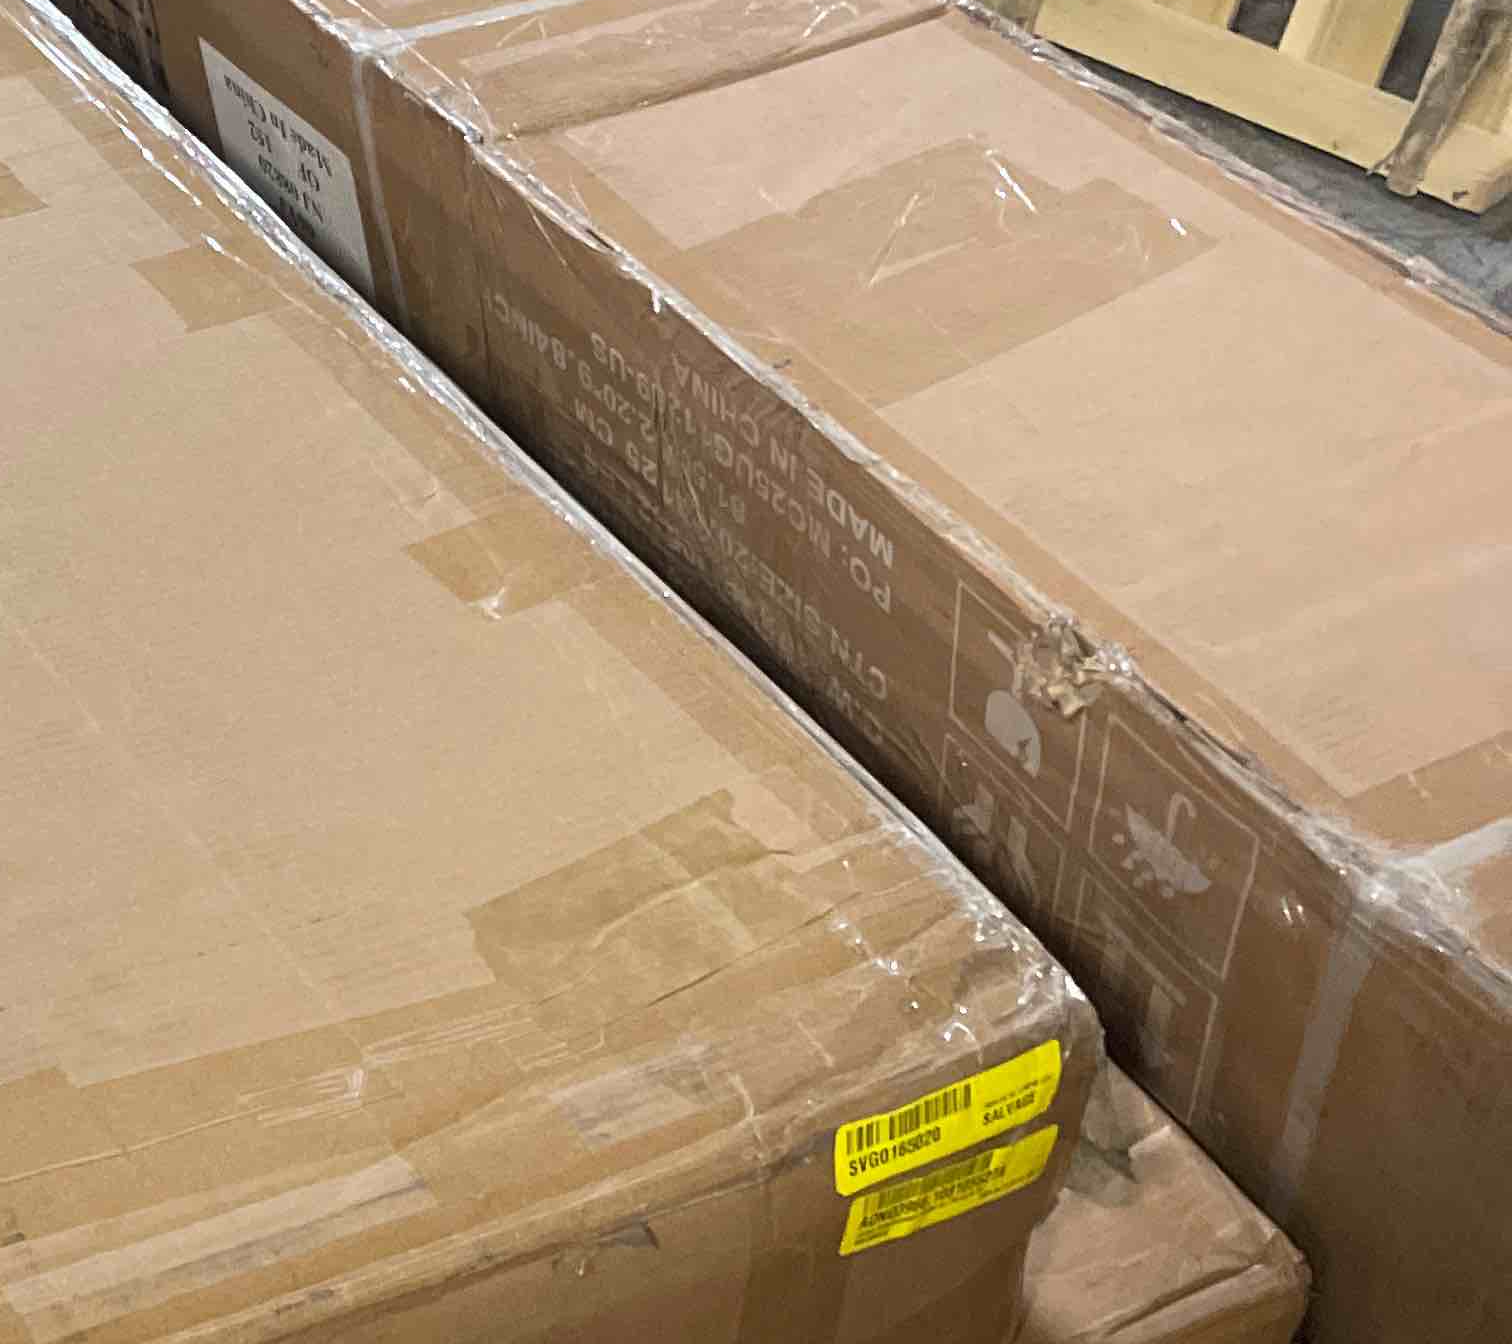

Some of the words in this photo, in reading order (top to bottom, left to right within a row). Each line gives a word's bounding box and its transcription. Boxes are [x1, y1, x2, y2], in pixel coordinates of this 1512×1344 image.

[672, 355, 761, 447] CHINA
[769, 436, 803, 484] IN
[805, 467, 894, 570] MADE
[831, 627, 888, 700] CTN
